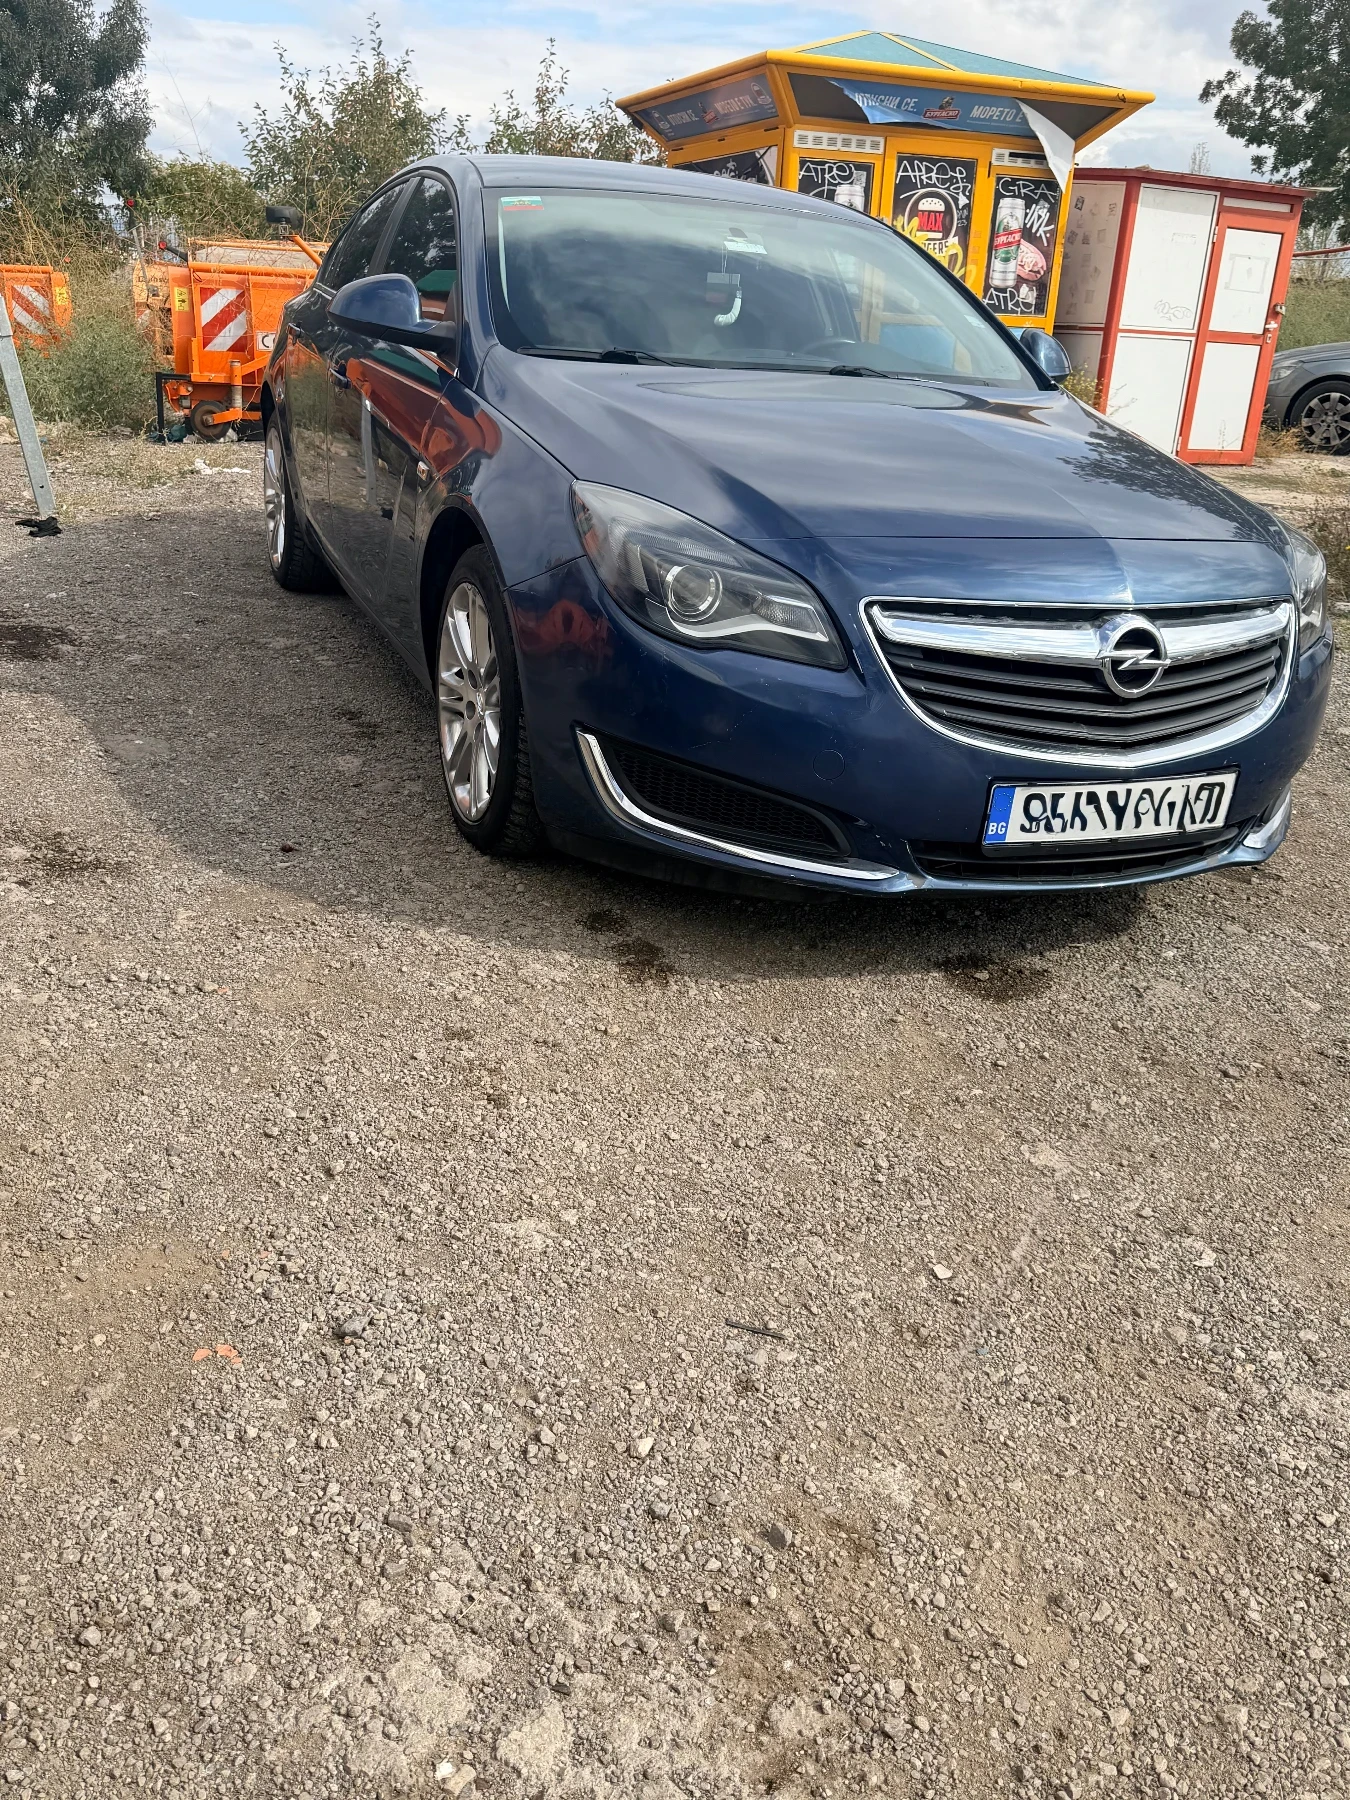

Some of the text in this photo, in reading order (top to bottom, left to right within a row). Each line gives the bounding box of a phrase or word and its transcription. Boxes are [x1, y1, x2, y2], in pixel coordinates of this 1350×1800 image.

[970, 105, 1016, 122] МОРЕТО
[917, 211, 944, 231] MAX
[988, 822, 1006, 834] BG
